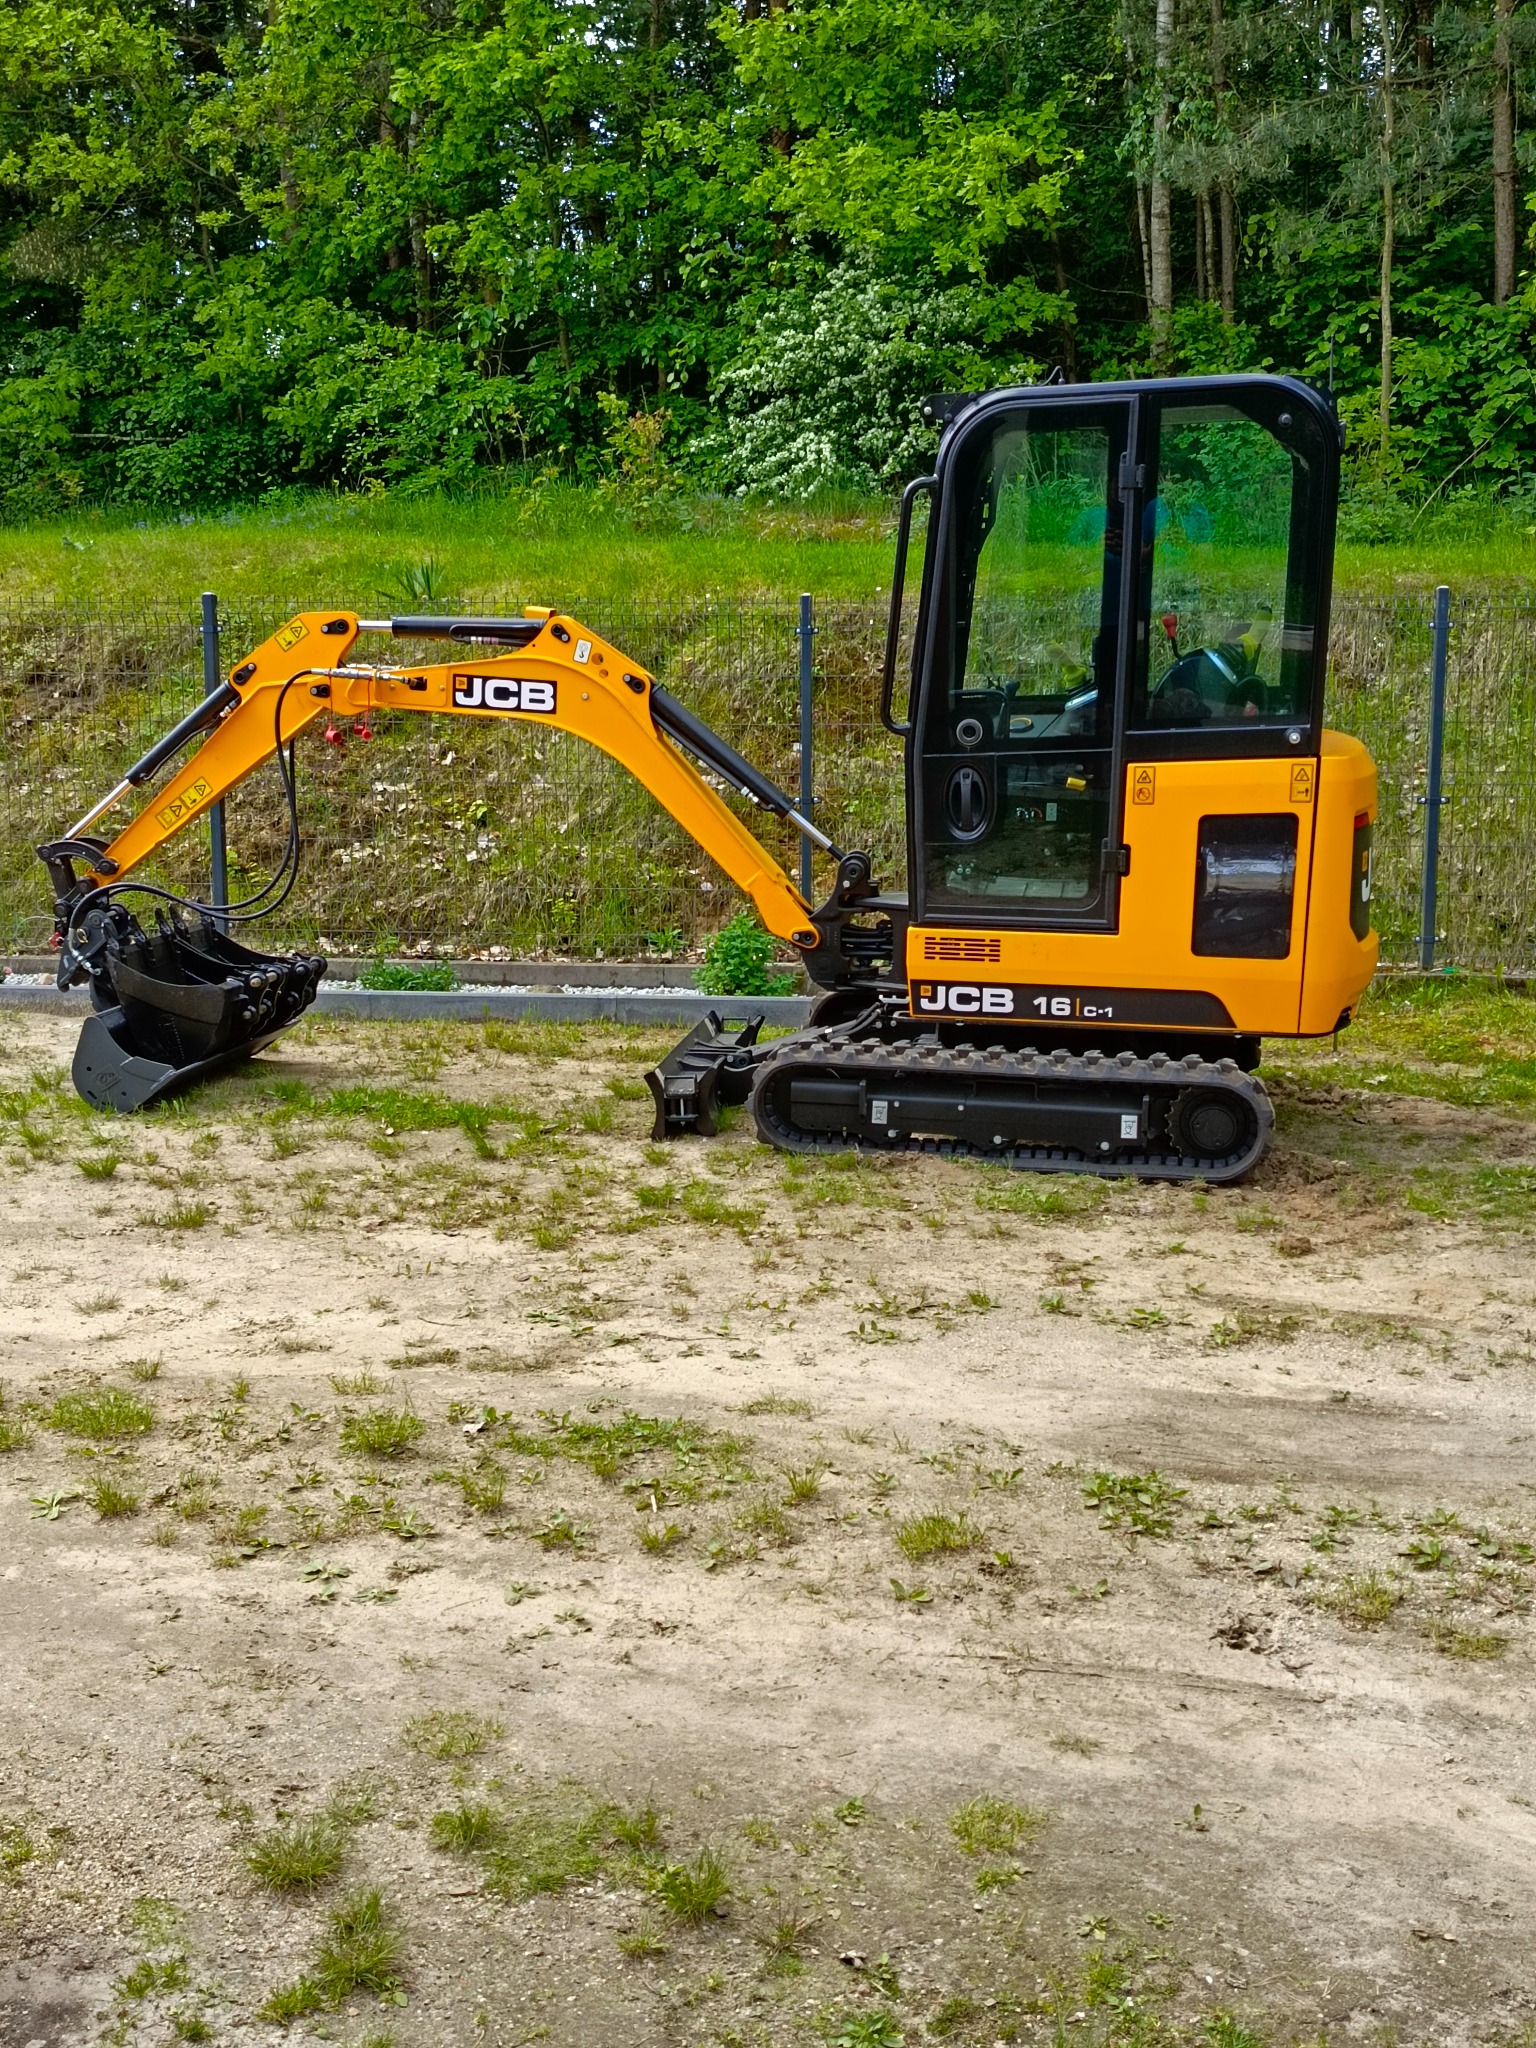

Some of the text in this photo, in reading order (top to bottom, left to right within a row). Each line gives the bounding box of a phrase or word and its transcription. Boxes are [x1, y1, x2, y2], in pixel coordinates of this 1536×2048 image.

[455, 677, 555, 712] JCB
[920, 985, 1015, 1014] JCB
[1033, 996, 1072, 1016] 16
